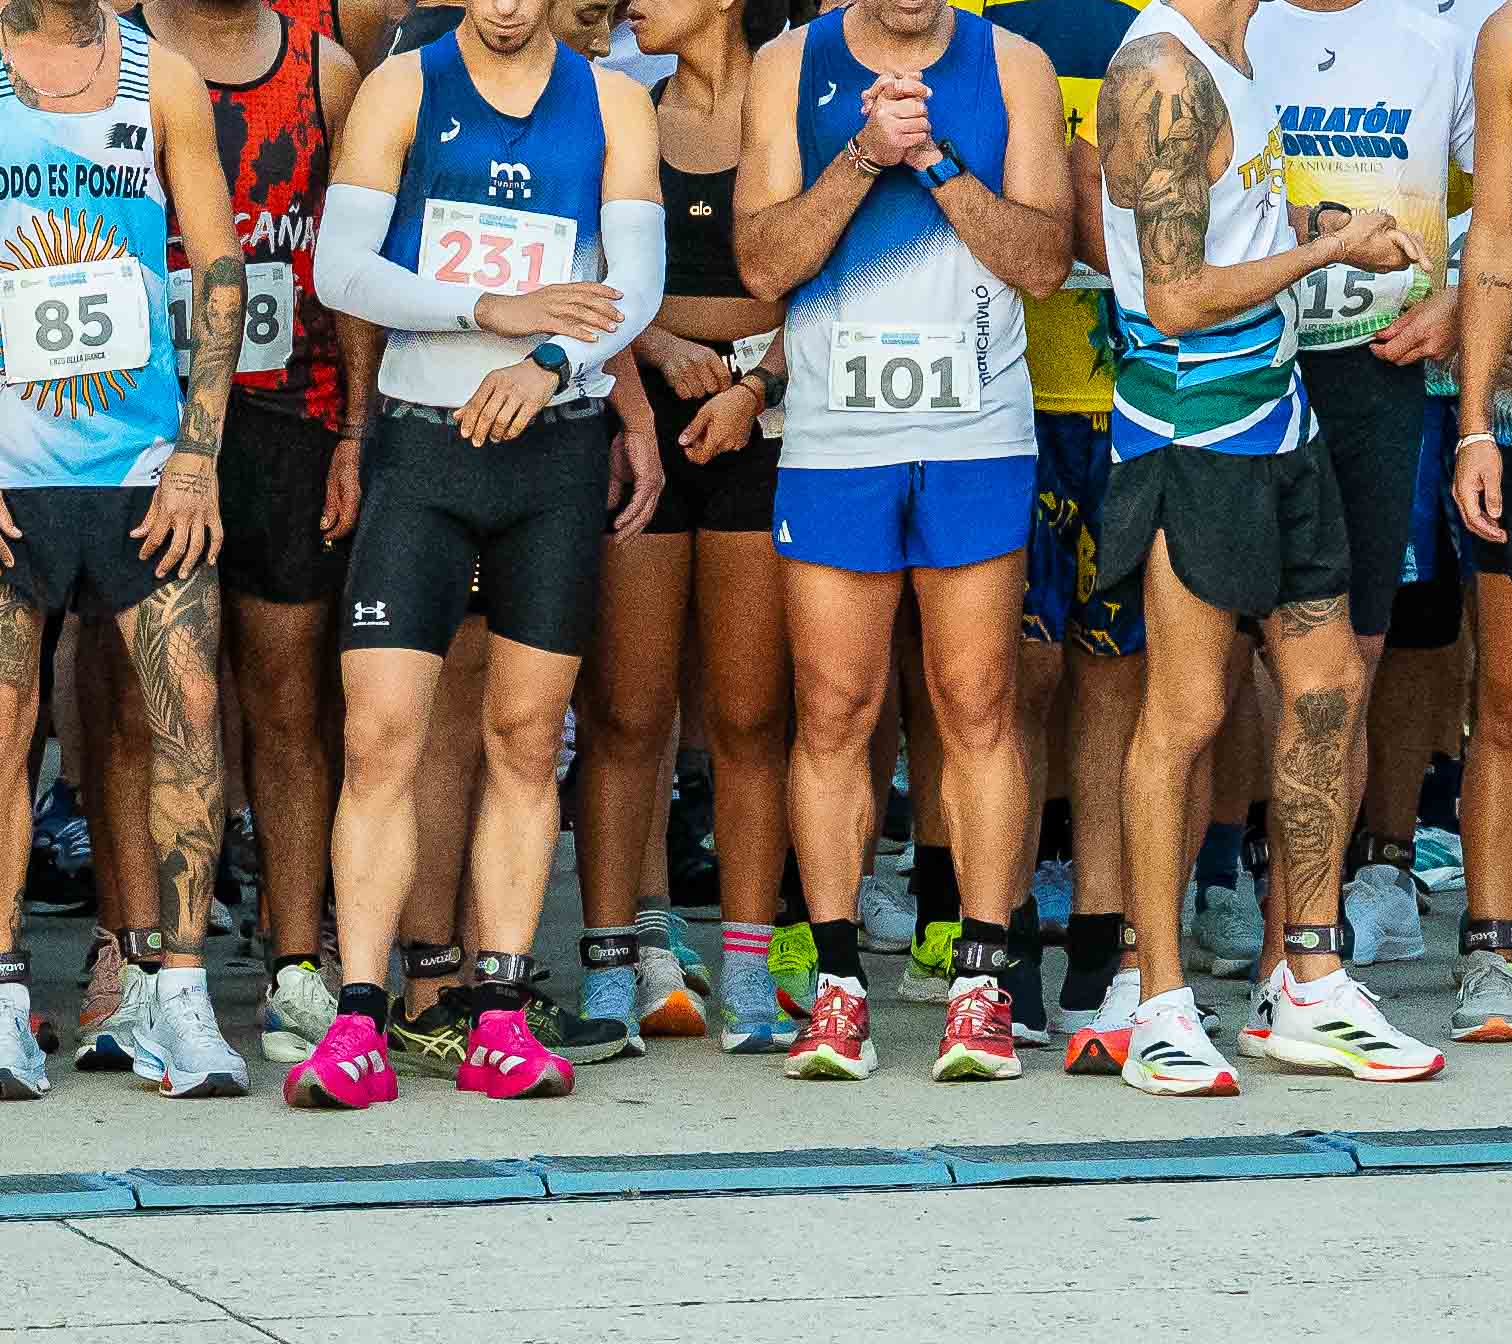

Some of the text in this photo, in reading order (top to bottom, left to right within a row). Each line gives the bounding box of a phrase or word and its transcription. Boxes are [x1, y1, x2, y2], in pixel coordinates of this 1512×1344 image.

[1276, 102, 1412, 135] ARATÓN
[1282, 133, 1409, 160] ORTONDO
[48, 163, 69, 197] ES
[76, 164, 151, 199] POSIBLE
[690, 201, 712, 216] alo
[434, 230, 544, 292] 231
[1303, 270, 1376, 318] 15
[34, 293, 113, 352] 85
[845, 355, 962, 409] 101
